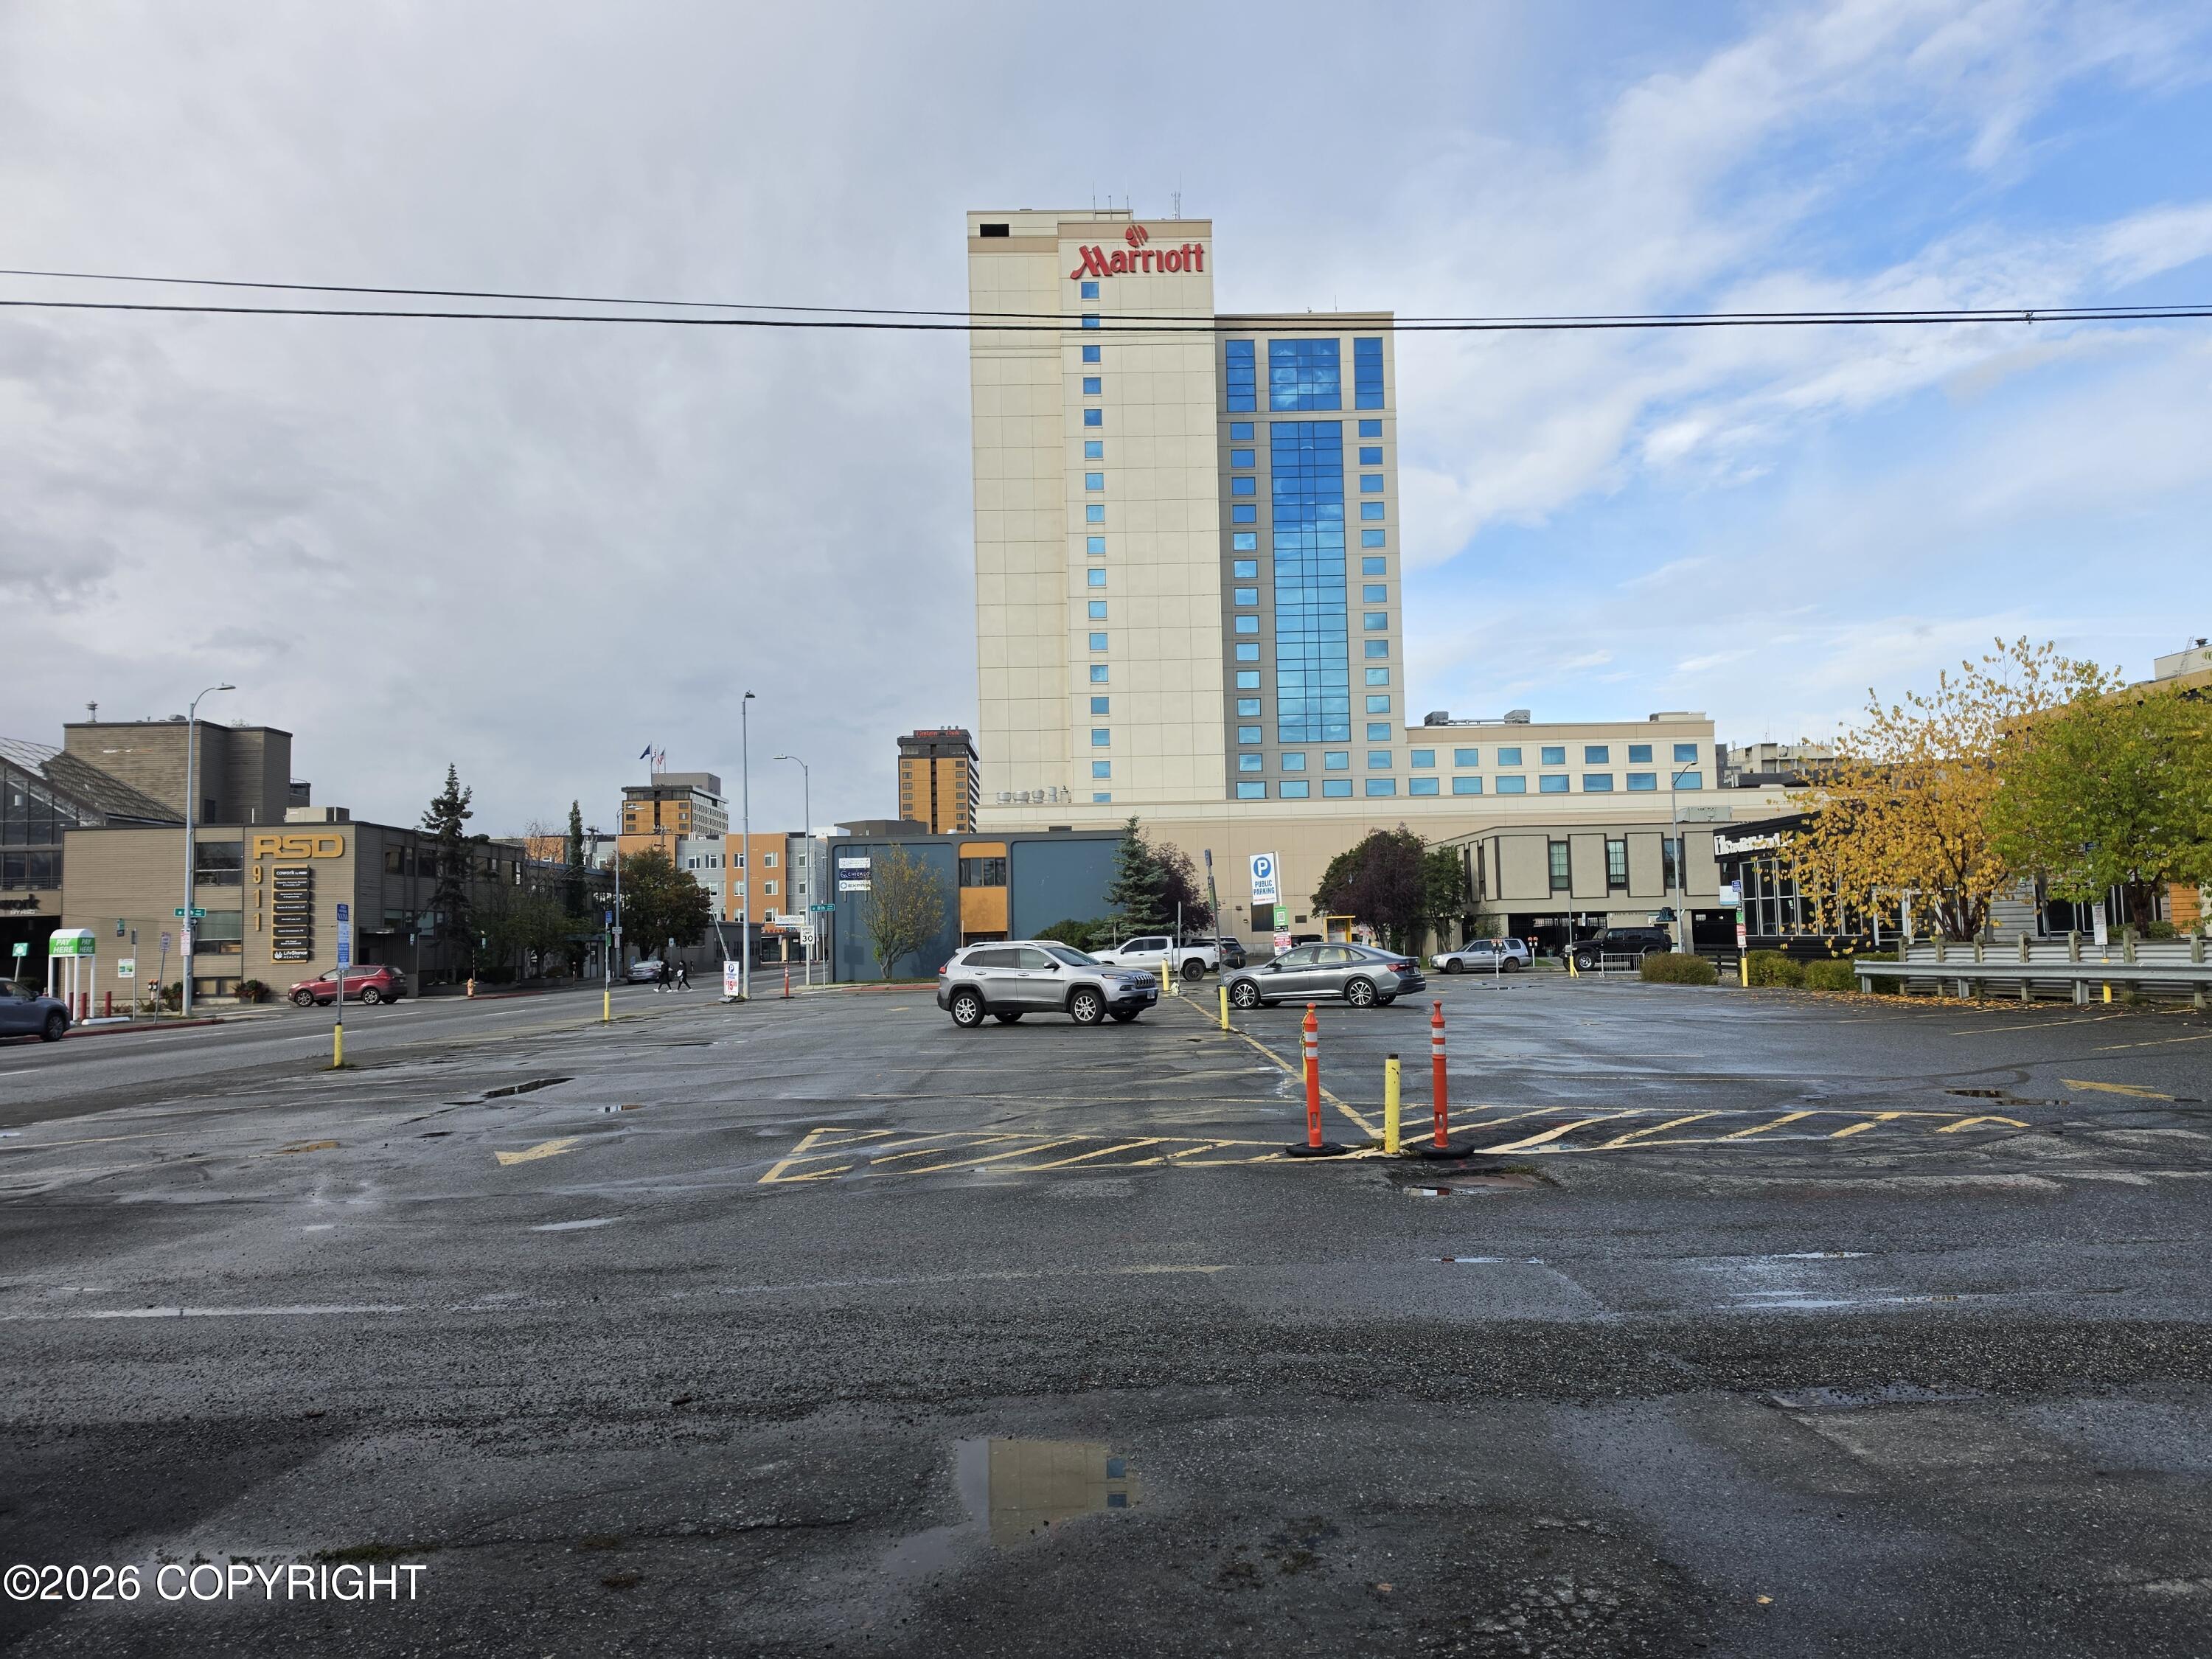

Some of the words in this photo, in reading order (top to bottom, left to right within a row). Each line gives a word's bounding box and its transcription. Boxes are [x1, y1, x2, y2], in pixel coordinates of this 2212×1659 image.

[1070, 243, 1204, 279] Marriott
[253, 834, 344, 859] RSD
[1253, 887, 1275, 896] PARKING
[1255, 880, 1273, 888] PUBLIC
